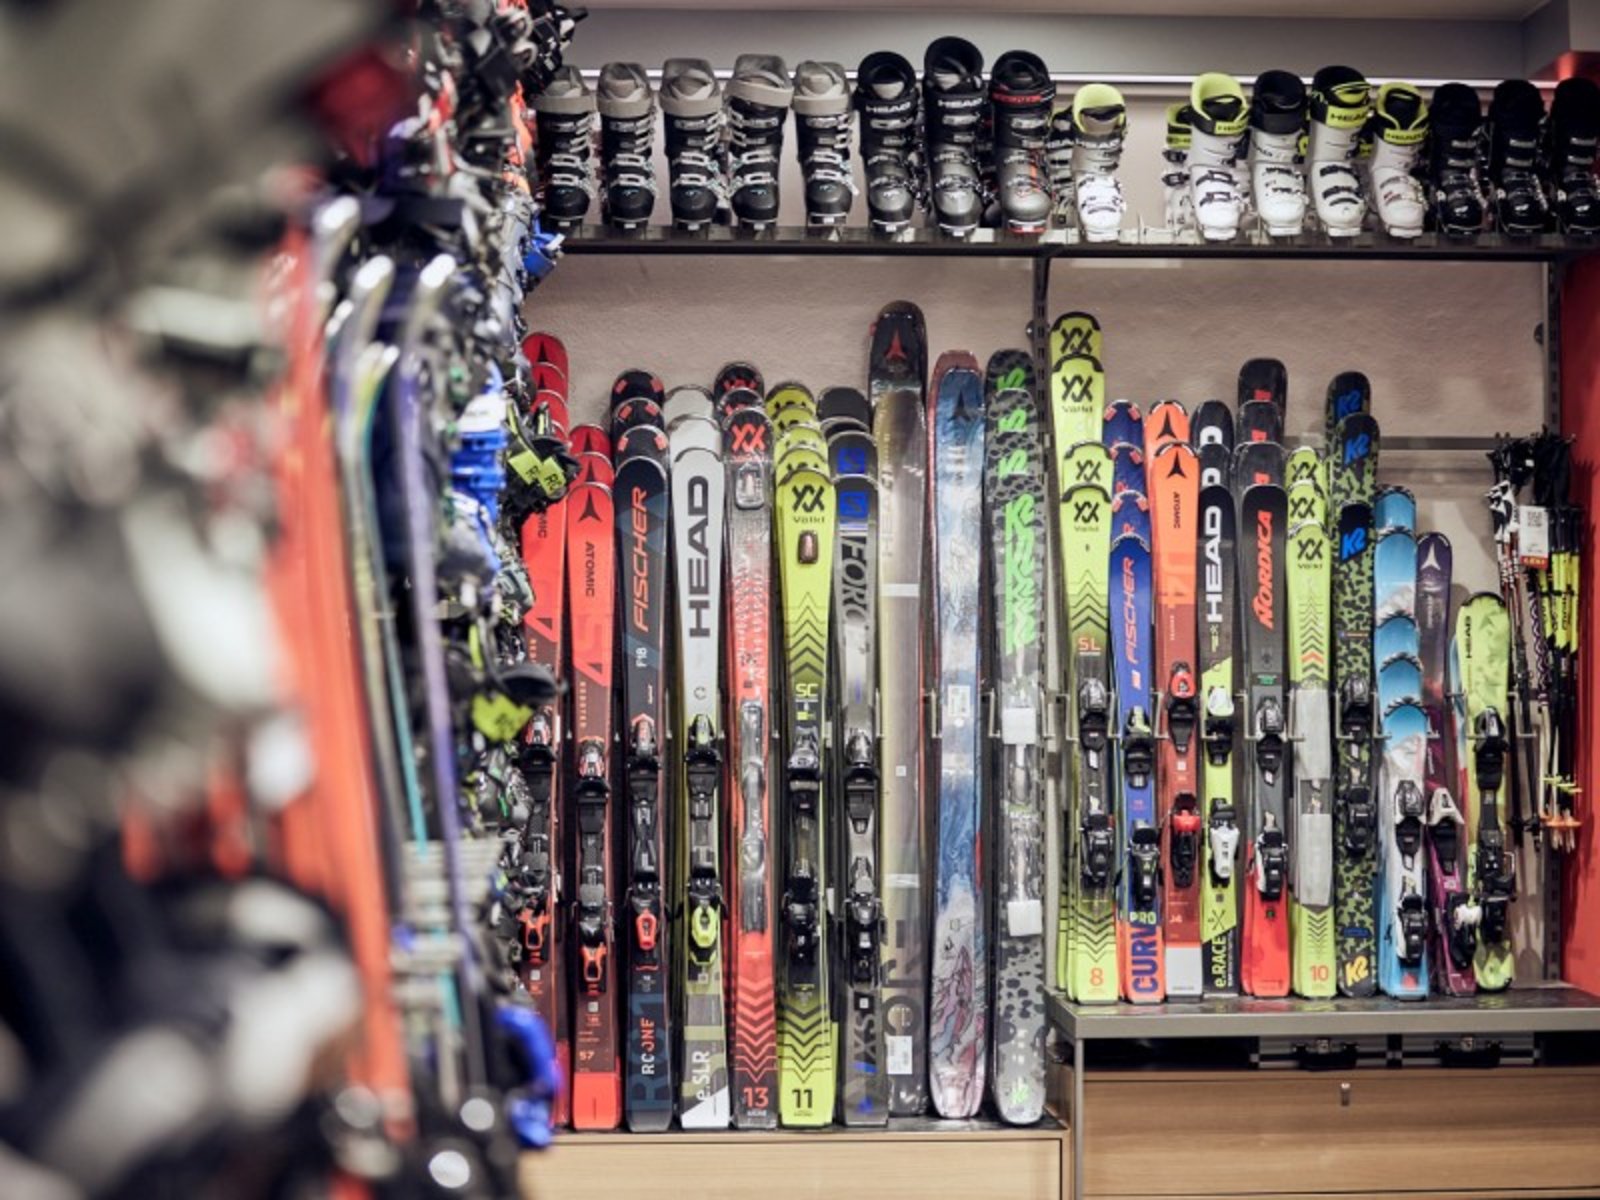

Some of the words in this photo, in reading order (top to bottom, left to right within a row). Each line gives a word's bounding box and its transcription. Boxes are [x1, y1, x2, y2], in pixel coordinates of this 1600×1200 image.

[630, 485, 648, 633] FISCHER
[687, 474, 711, 638] HEAD
[1341, 527, 1368, 561] K2
[585, 541, 595, 598] ATOMIC
[1205, 505, 1223, 622] HEAD
[1252, 510, 1274, 630] NORDICA
[1122, 557, 1139, 664] FISCHER
[1079, 637, 1101, 651] SL
[795, 683, 818, 698] SC
[1090, 967, 1103, 987] 8
[1310, 964, 1329, 982] 10
[1345, 955, 1369, 987] K2
[641, 1017, 654, 1051] ONE
[641, 1052, 655, 1075] RC
[691, 1051, 711, 1101] e.SLR
[743, 1087, 769, 1109] 13
[792, 1088, 814, 1109] 11
